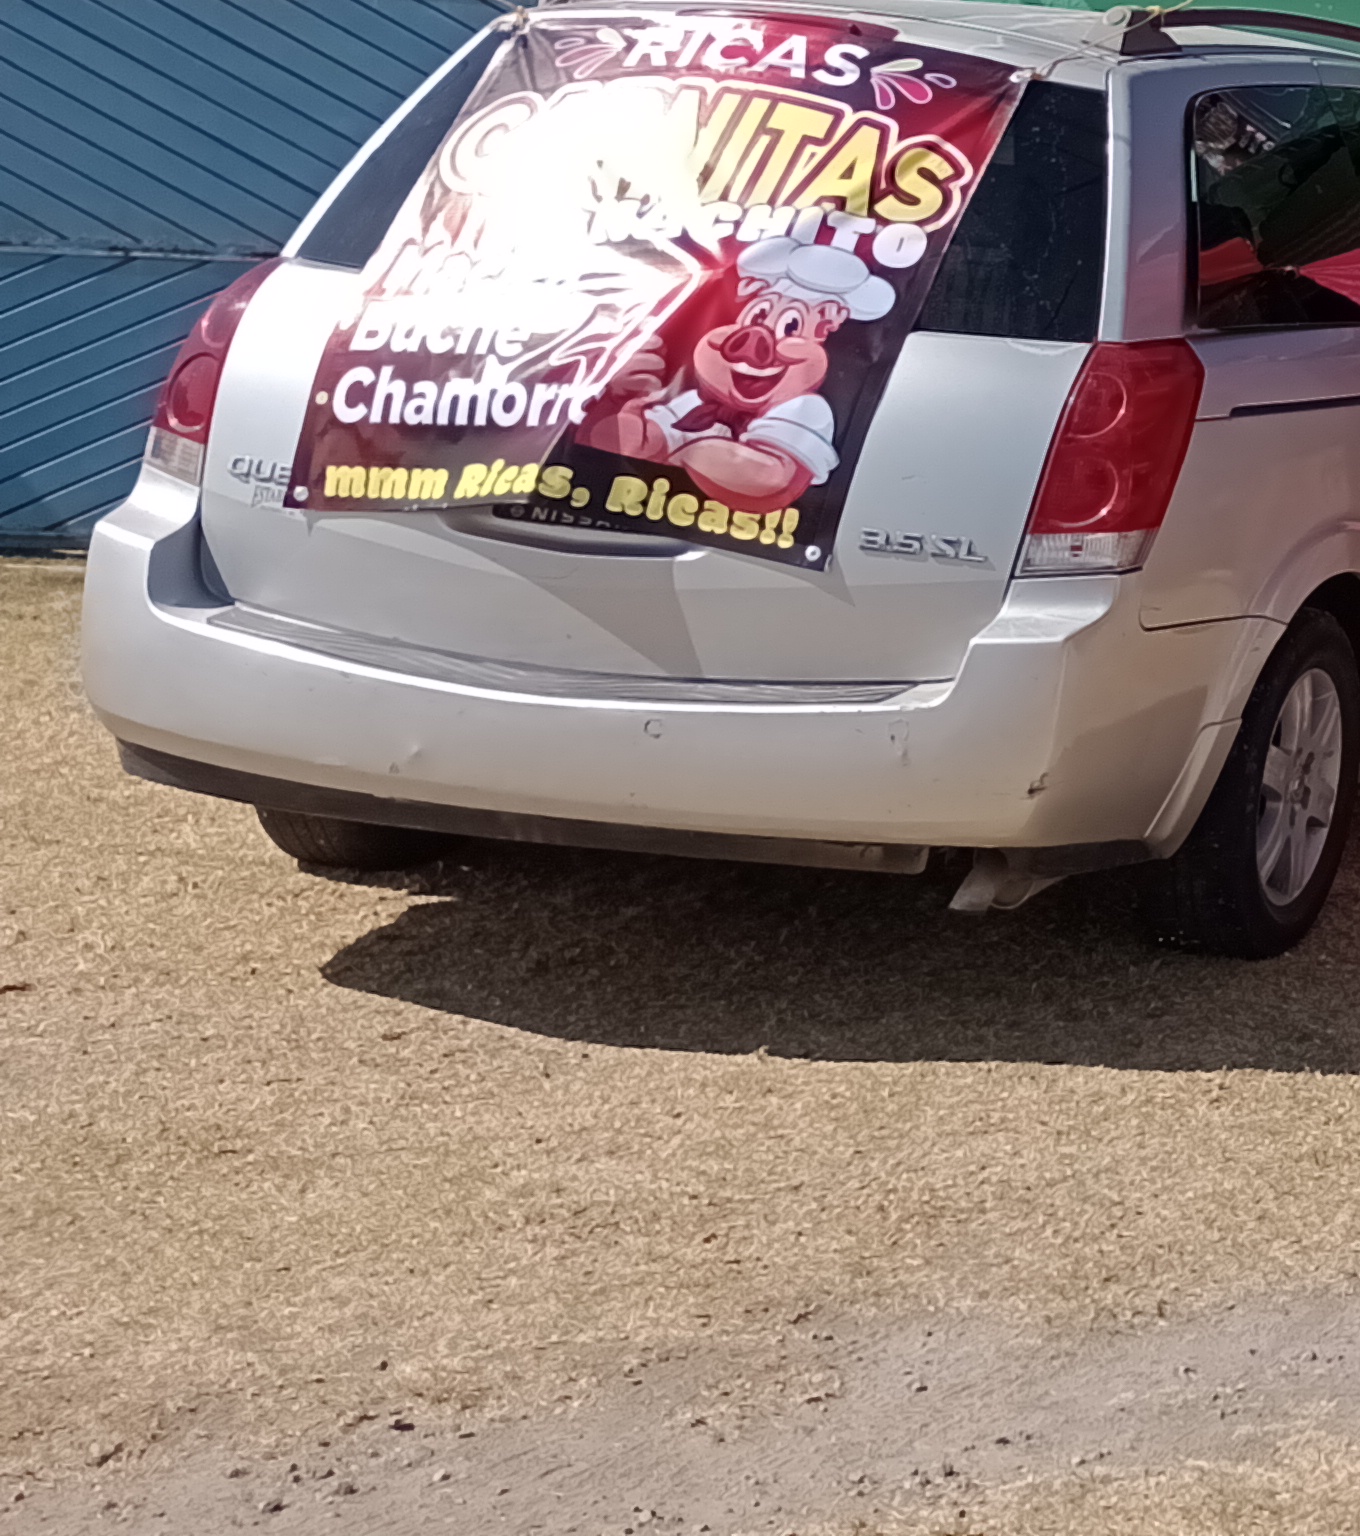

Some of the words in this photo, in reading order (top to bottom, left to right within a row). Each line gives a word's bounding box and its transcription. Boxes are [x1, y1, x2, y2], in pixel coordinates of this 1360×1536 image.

[622, 20, 870, 87] RICAS
[324, 465, 450, 499] mmm
[453, 458, 591, 508] Ricas,
[605, 476, 800, 548] Ricas!!
[930, 534, 989, 563] SL
